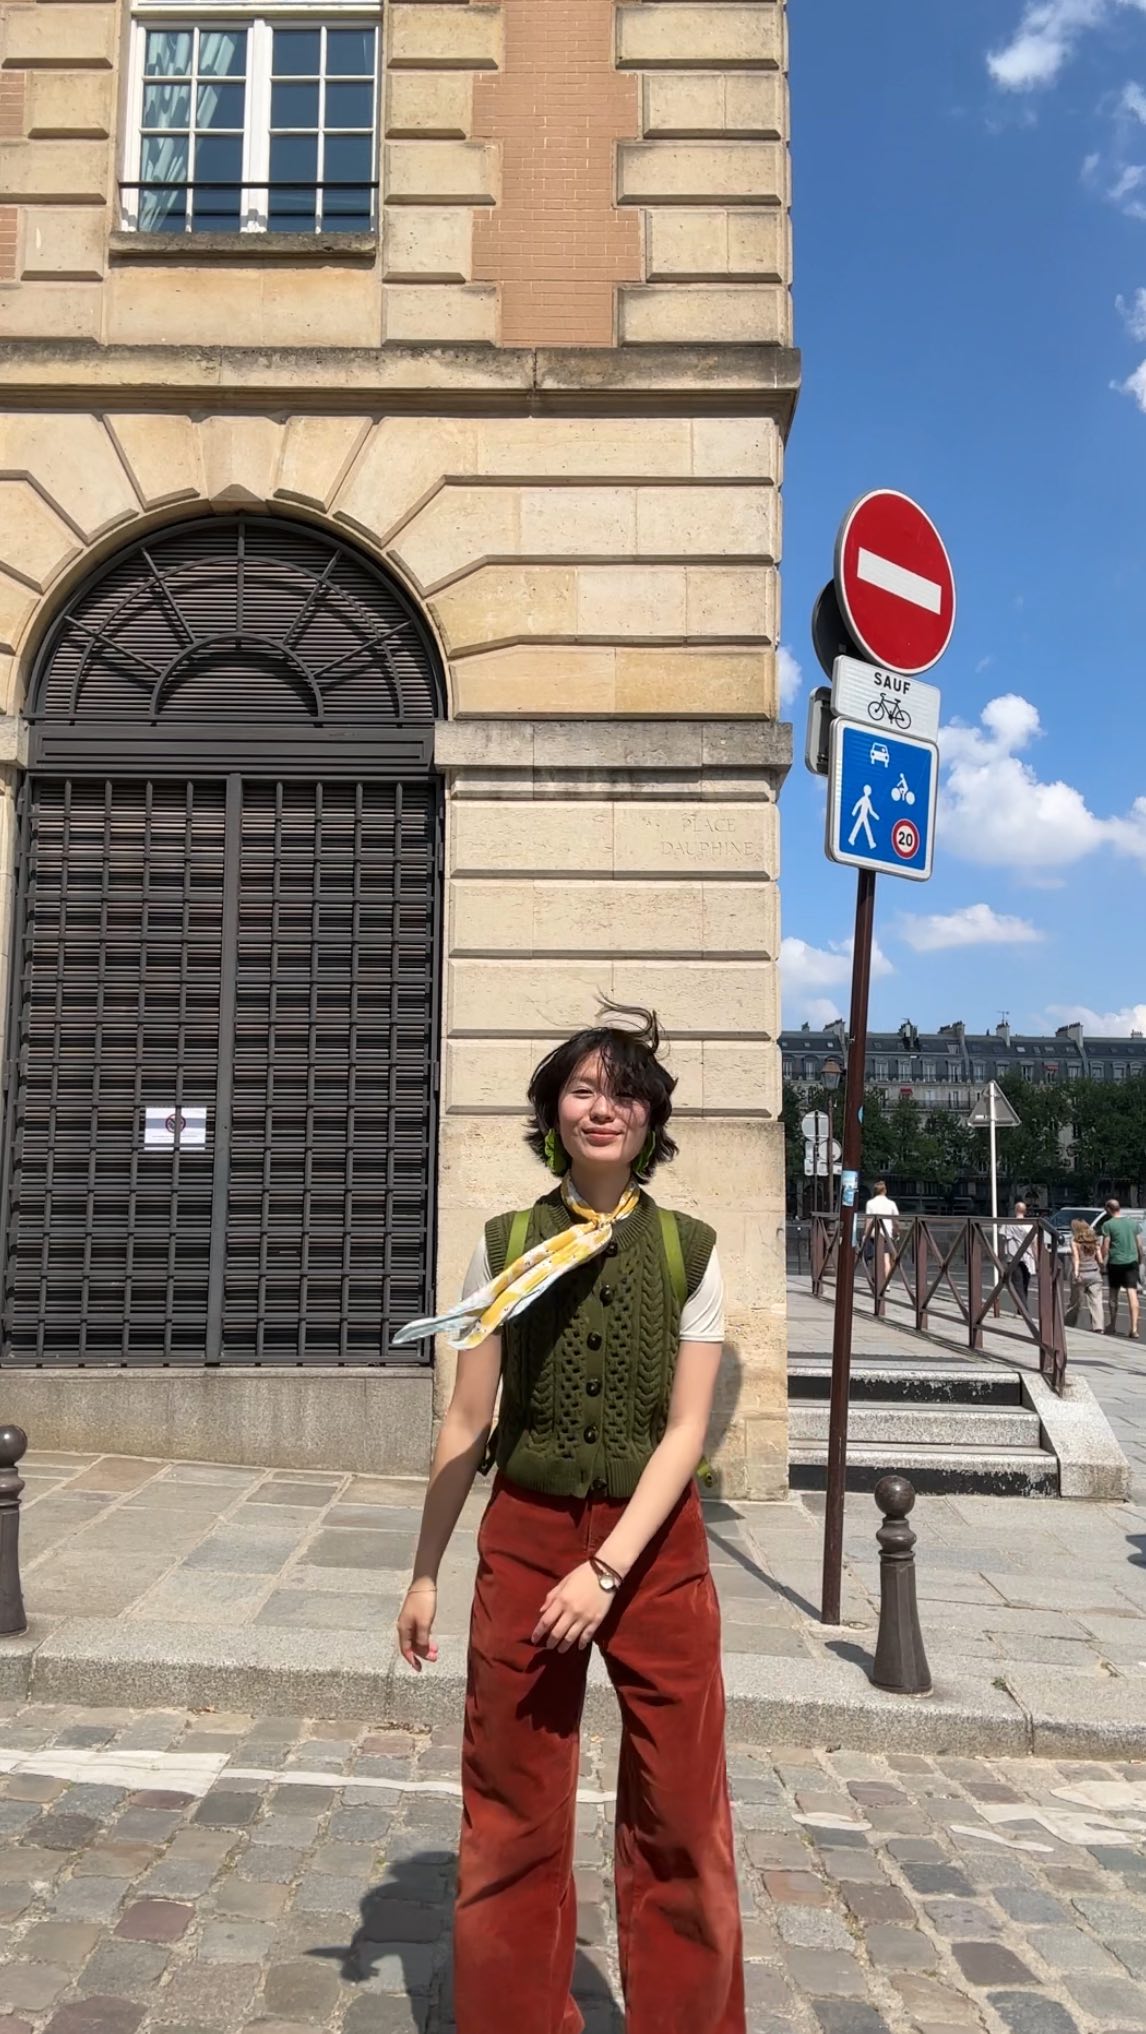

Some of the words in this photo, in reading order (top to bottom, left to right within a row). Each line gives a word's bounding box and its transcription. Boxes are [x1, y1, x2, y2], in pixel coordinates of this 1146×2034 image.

[874, 672, 911, 695] SAUF
[682, 817, 736, 832] PLACE
[898, 831, 913, 847] 20
[662, 841, 754, 855] DAUPHINE
